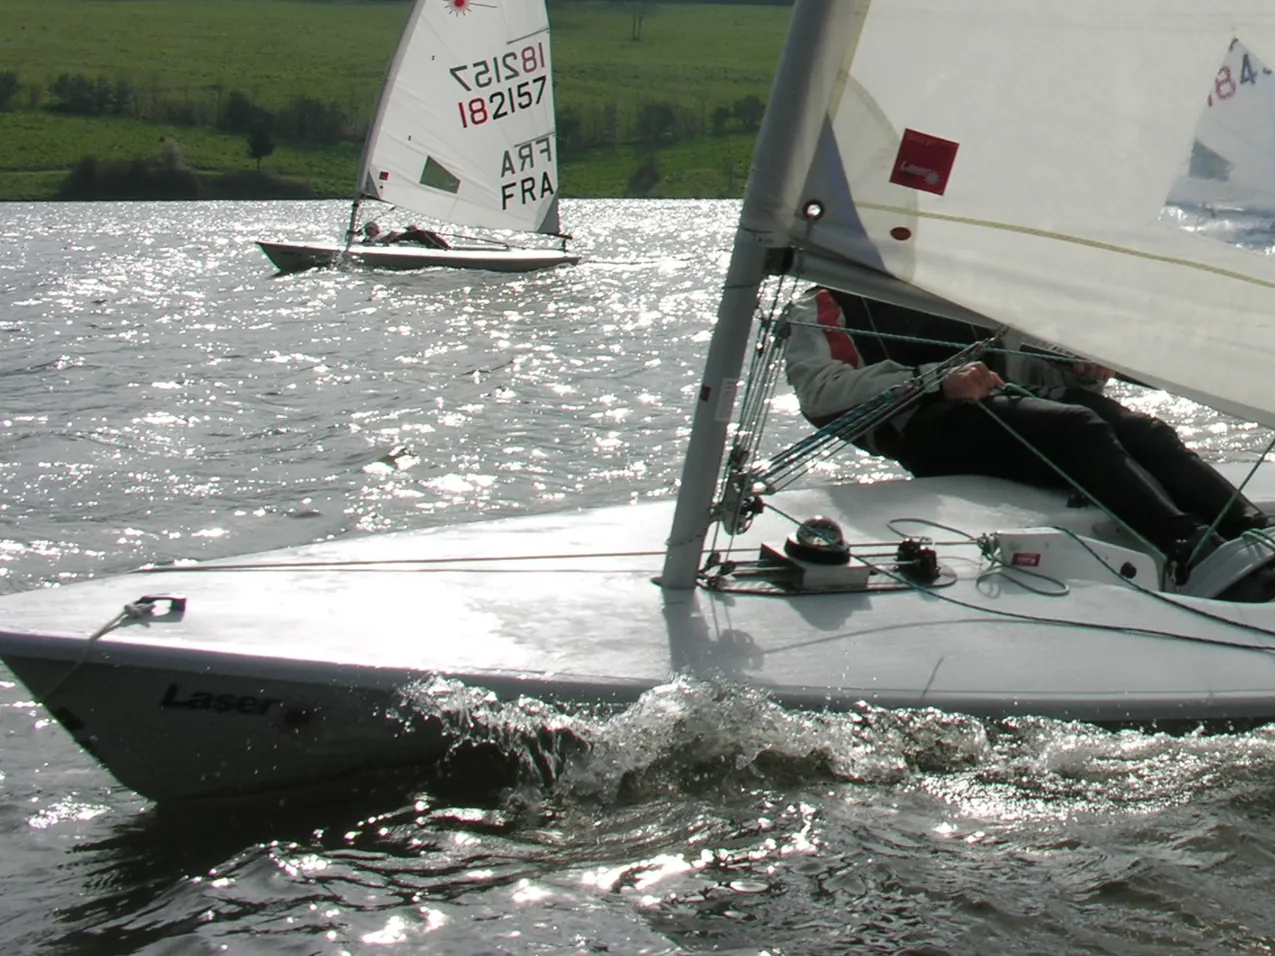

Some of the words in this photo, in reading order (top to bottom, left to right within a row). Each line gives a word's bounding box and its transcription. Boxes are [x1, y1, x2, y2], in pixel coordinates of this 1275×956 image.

[458, 75, 546, 129] 182157
[1207, 53, 1273, 108] 84
[501, 171, 554, 211] FRA
[160, 683, 282, 715] Laser
